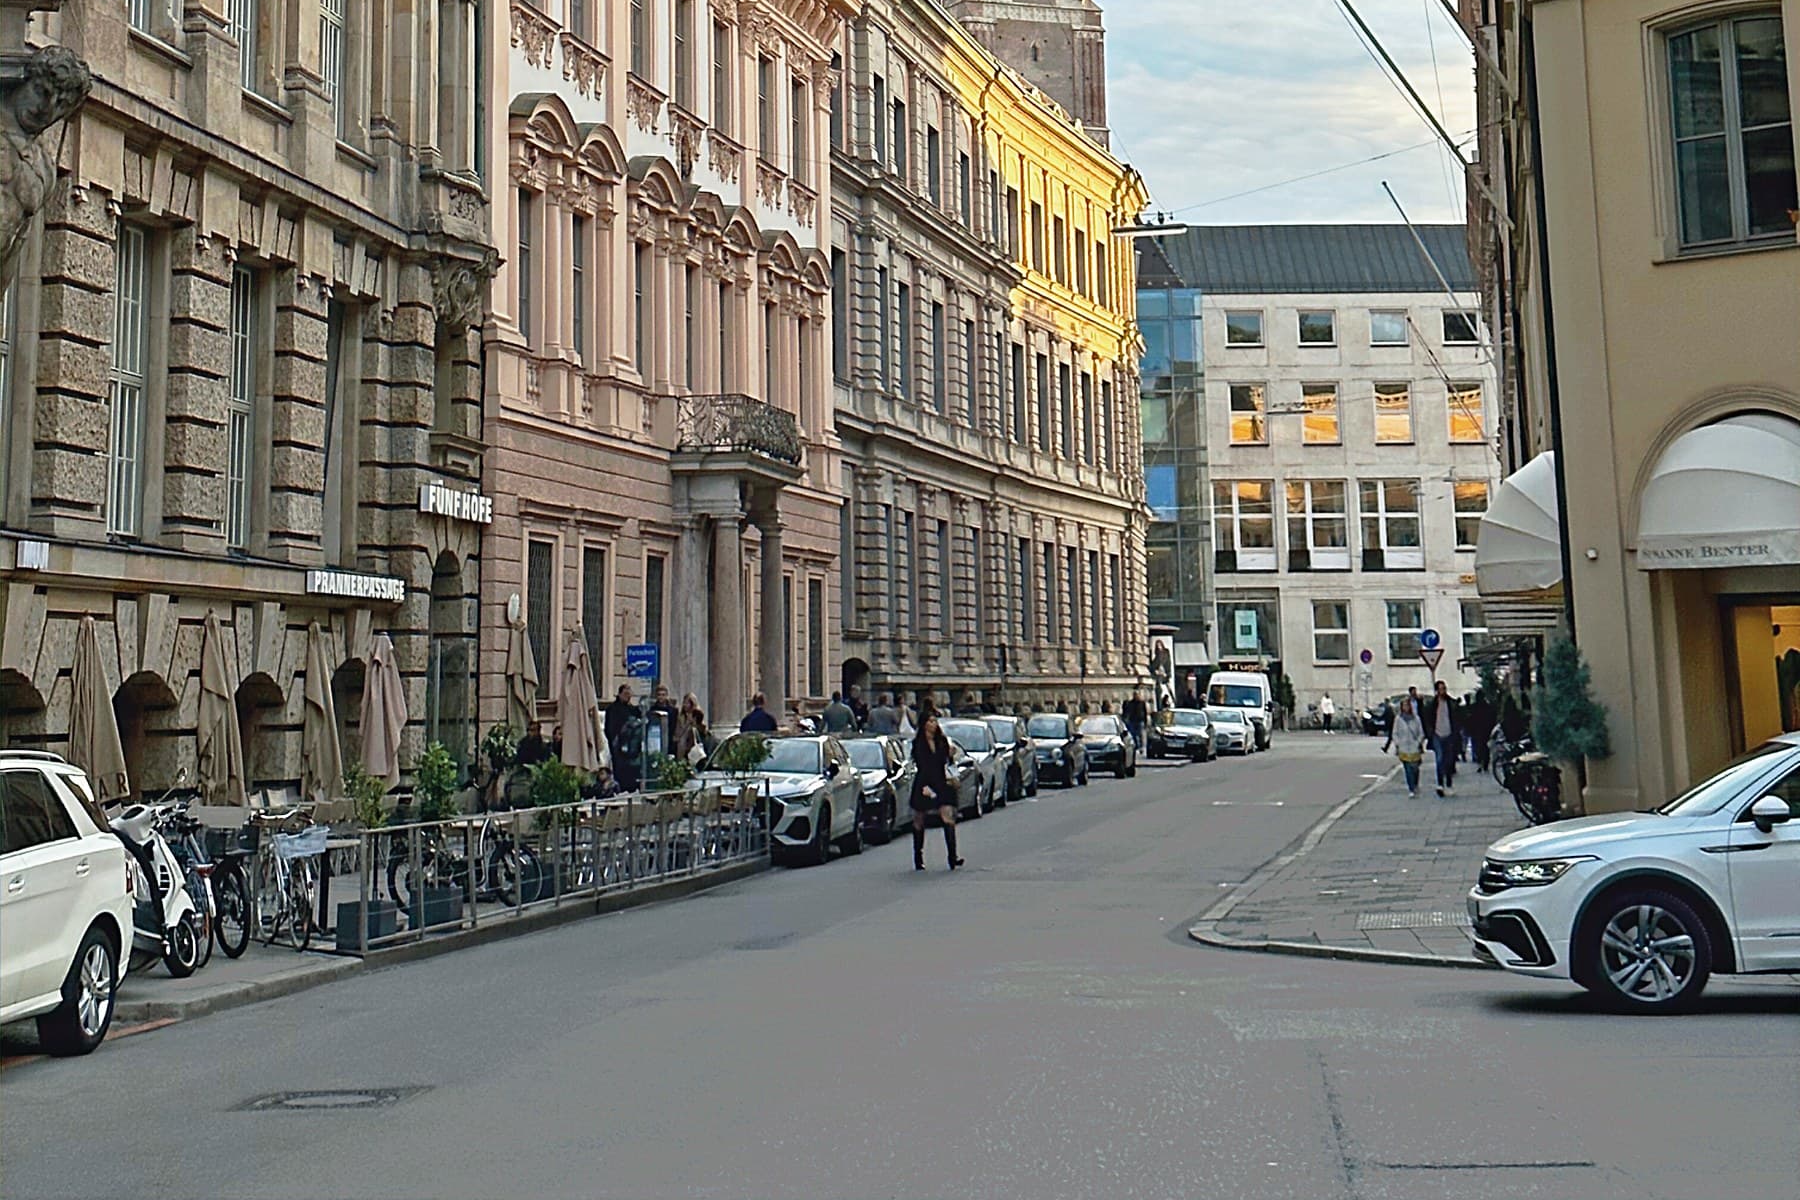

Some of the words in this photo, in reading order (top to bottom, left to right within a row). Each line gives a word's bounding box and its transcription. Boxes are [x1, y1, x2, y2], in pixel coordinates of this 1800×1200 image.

[429, 480, 461, 519] FÜNF
[462, 488, 492, 524] HÖFE
[1700, 544, 1769, 558] BENTER
[314, 570, 405, 601] PRANNERPASSAGE
